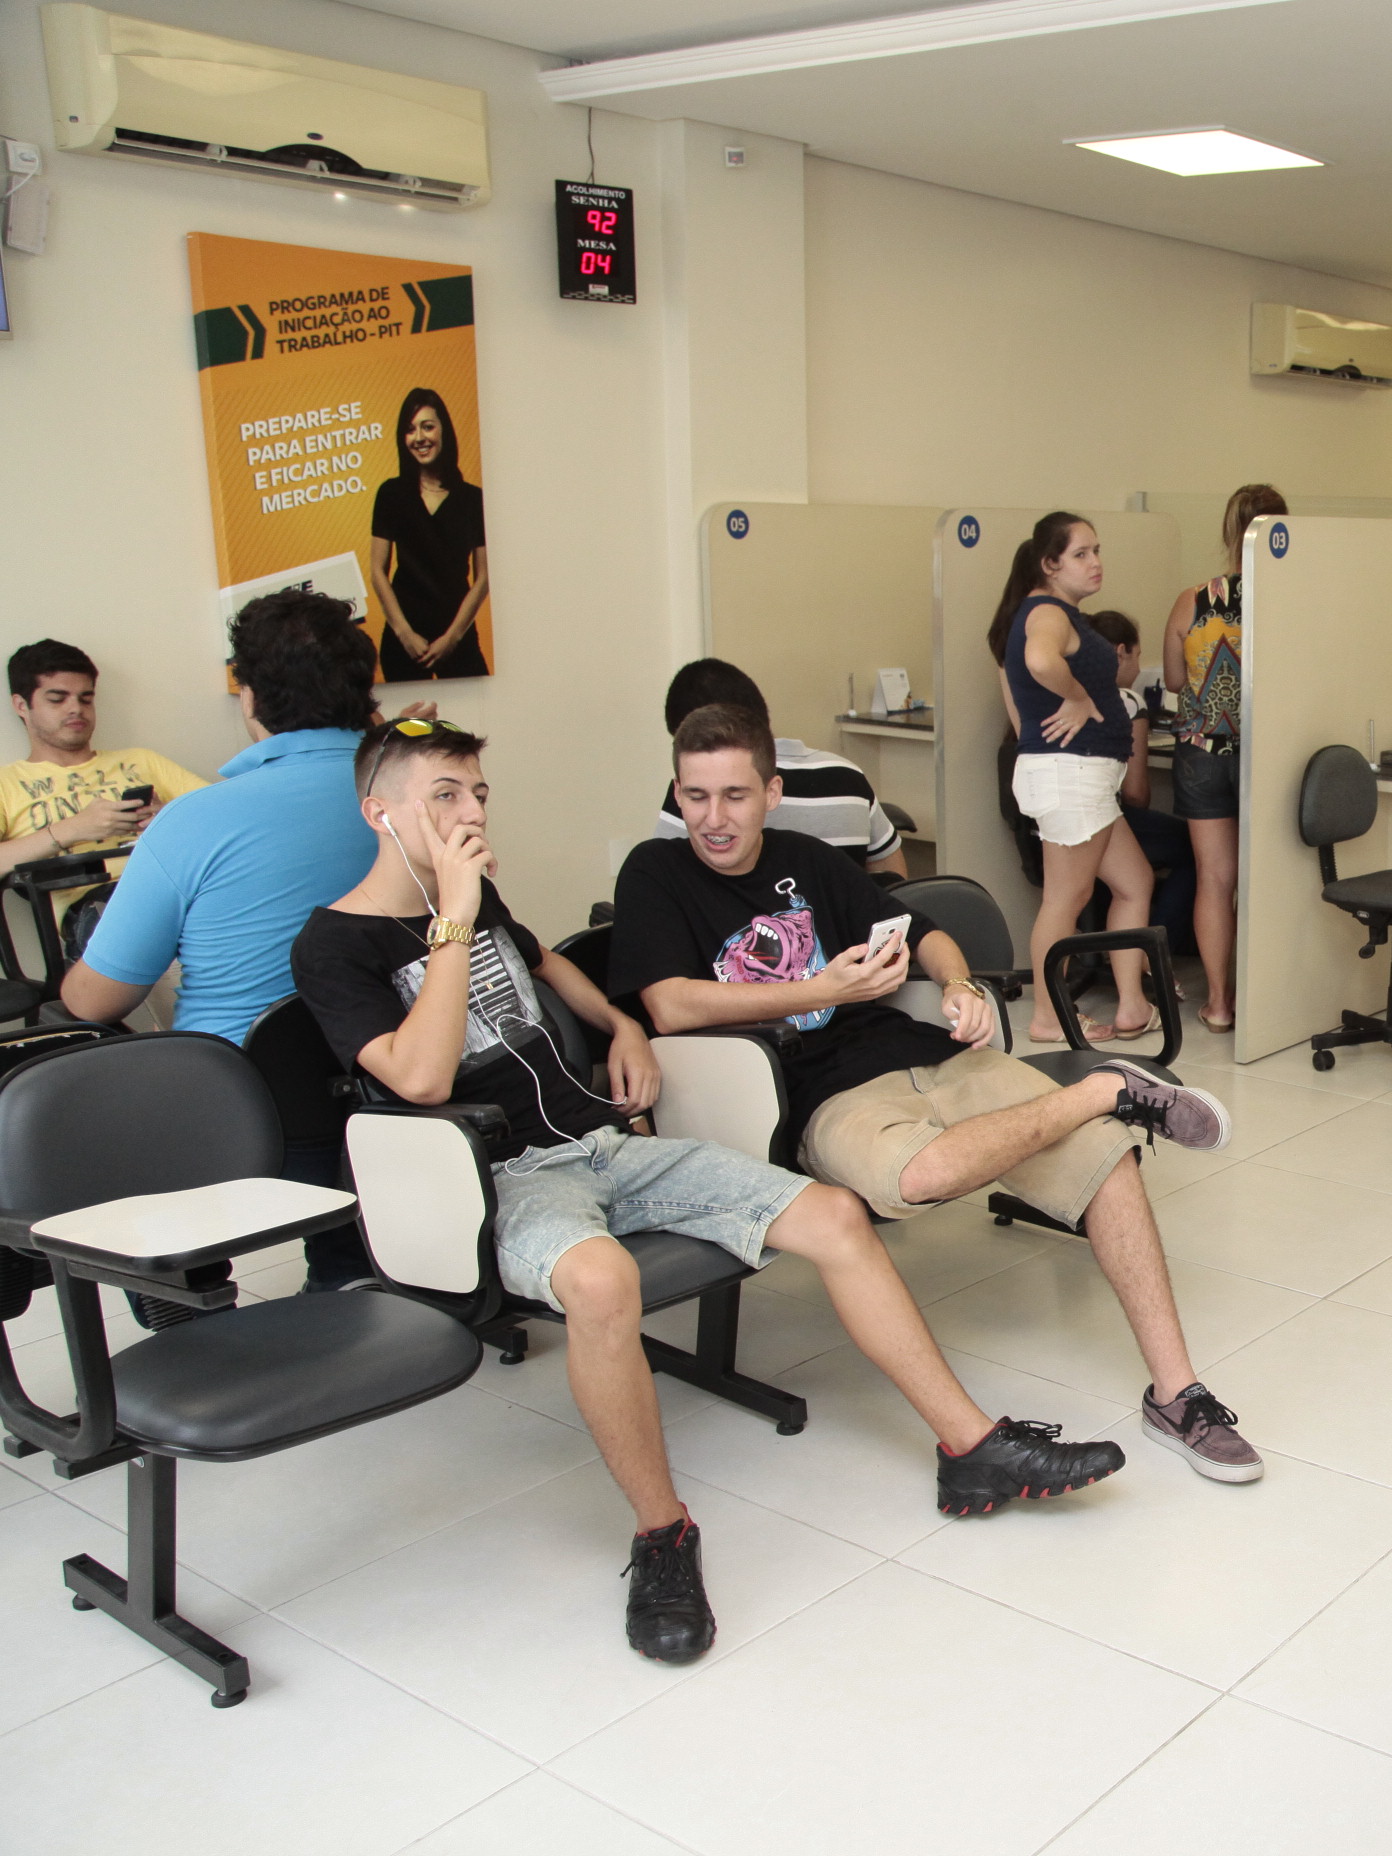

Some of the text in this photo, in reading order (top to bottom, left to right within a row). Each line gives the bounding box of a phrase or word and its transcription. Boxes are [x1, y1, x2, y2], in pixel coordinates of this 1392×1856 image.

[565, 184, 626, 199] ACOLHIMENTO
[571, 195, 619, 209] SENHA
[586, 210, 617, 235] 92
[577, 239, 617, 251] MESA
[581, 251, 612, 275] 04
[269, 286, 391, 316] PROGRAMA DE
[278, 305, 390, 334] INICIAÇÃO AO
[276, 327, 367, 354] TRABALHO
[379, 322, 402, 339] PIT
[240, 401, 363, 442] PREPARE-SE
[247, 423, 383, 466] PARA ENTRAR
[254, 451, 363, 490] E FICAR NO
[262, 476, 367, 514] MERCADO.
[730, 517, 746, 531] 05
[961, 524, 976, 539] 04
[1272, 532, 1286, 549] 03
[19, 762, 147, 800] WALK
